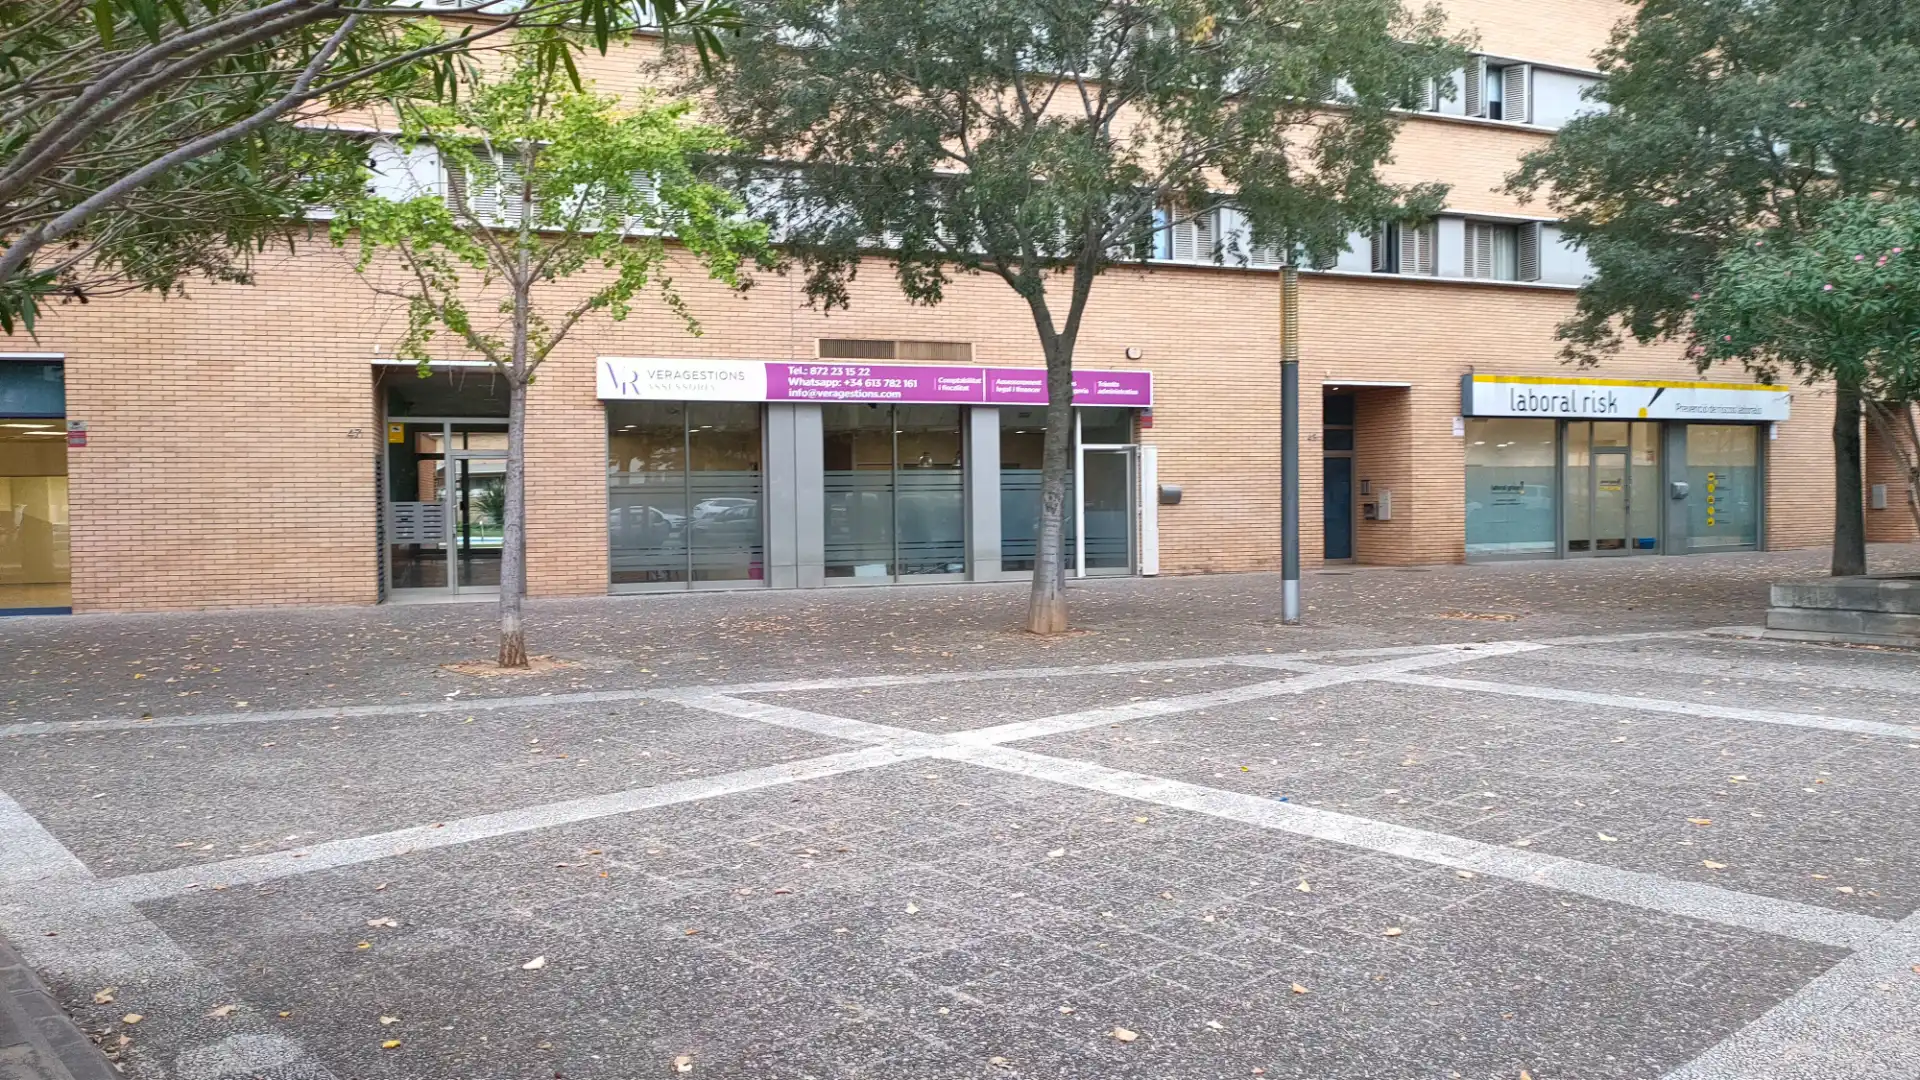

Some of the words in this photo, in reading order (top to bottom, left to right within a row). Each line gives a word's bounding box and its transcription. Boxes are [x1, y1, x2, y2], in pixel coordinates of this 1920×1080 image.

[647, 369, 745, 381] VERAGESTIONS
[810, 366, 828, 375] 872
[831, 367, 843, 376] 23
[845, 368, 855, 376] 15
[857, 368, 870, 376] 22
[788, 377, 841, 387] Whatsapp:
[843, 378, 862, 387] +34
[865, 379, 881, 387] 613
[883, 379, 901, 388] 782
[904, 380, 917, 388] 161
[788, 388, 901, 399] info@veragestions.com
[1510, 387, 1577, 413] laboral
[1583, 390, 1618, 413] risk
